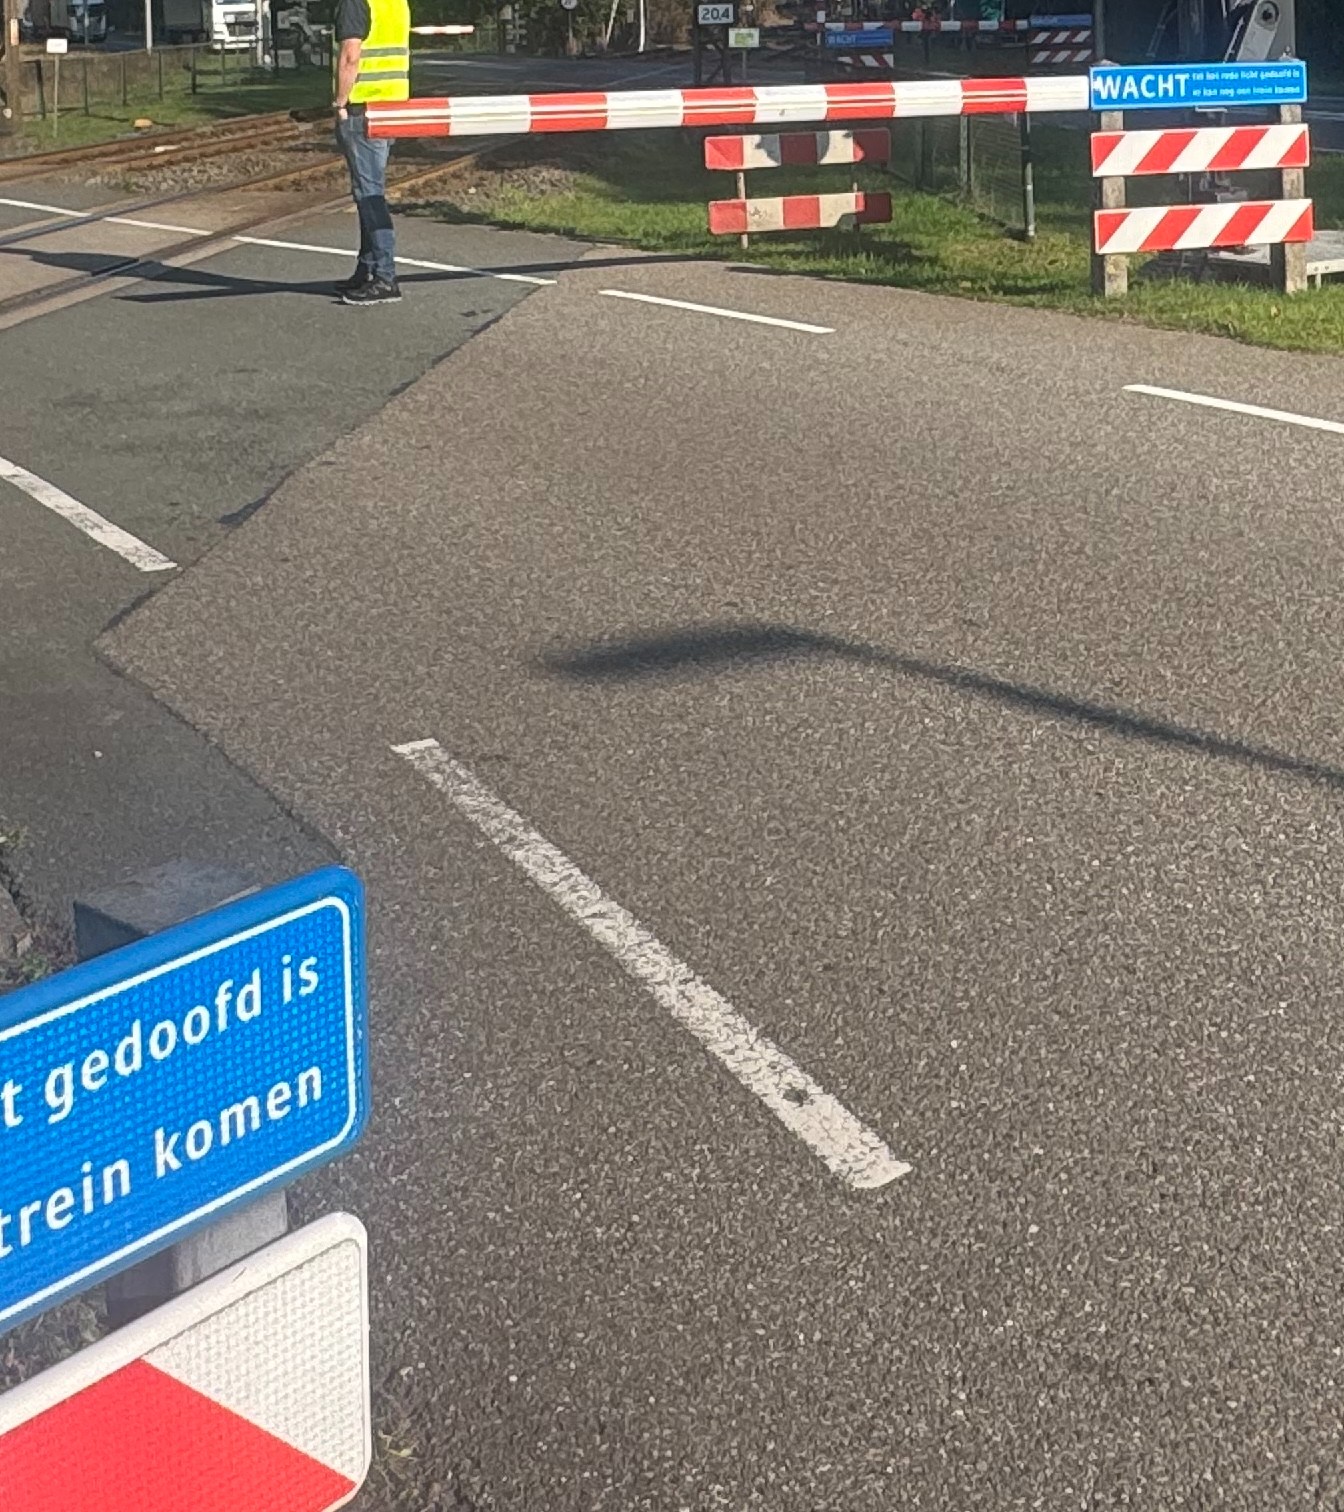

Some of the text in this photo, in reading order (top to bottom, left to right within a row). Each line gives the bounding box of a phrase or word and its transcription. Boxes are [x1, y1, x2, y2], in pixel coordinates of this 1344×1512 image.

[1096, 73, 1189, 100] WACHT
[44, 969, 262, 1125] gedoofd
[282, 954, 320, 1005] is
[154, 1065, 323, 1180] komen
